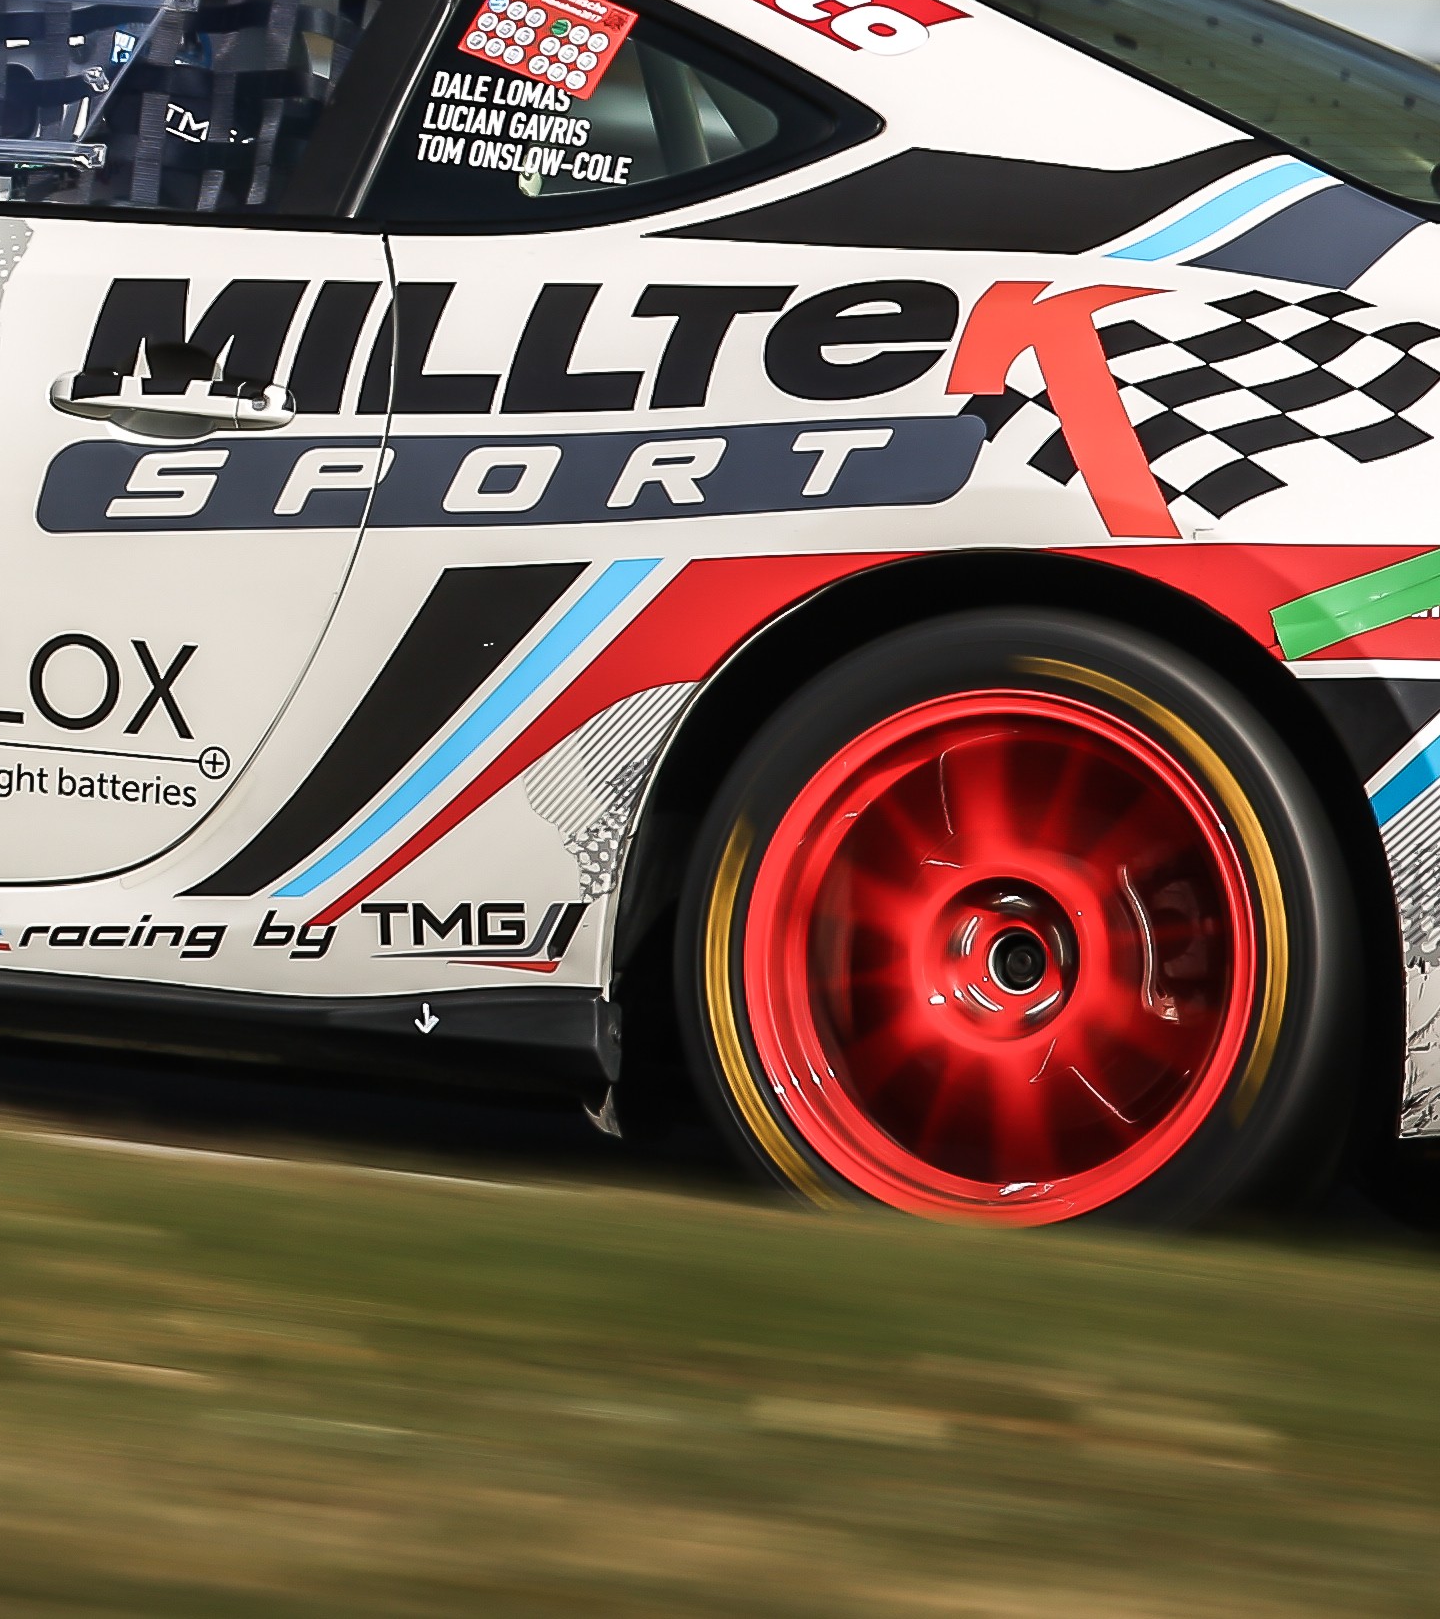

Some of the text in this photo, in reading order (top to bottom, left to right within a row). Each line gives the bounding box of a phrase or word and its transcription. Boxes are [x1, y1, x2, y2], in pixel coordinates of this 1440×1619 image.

[430, 71, 570, 112] DALE LOMAS
[423, 103, 590, 147] LUCIAN GAVRIS
[417, 133, 632, 185] TOM ONSLOW-COLE
[106, 427, 892, 517] SPORT
[56, 772, 197, 808] batteries
[20, 902, 525, 959] racing by TMG
